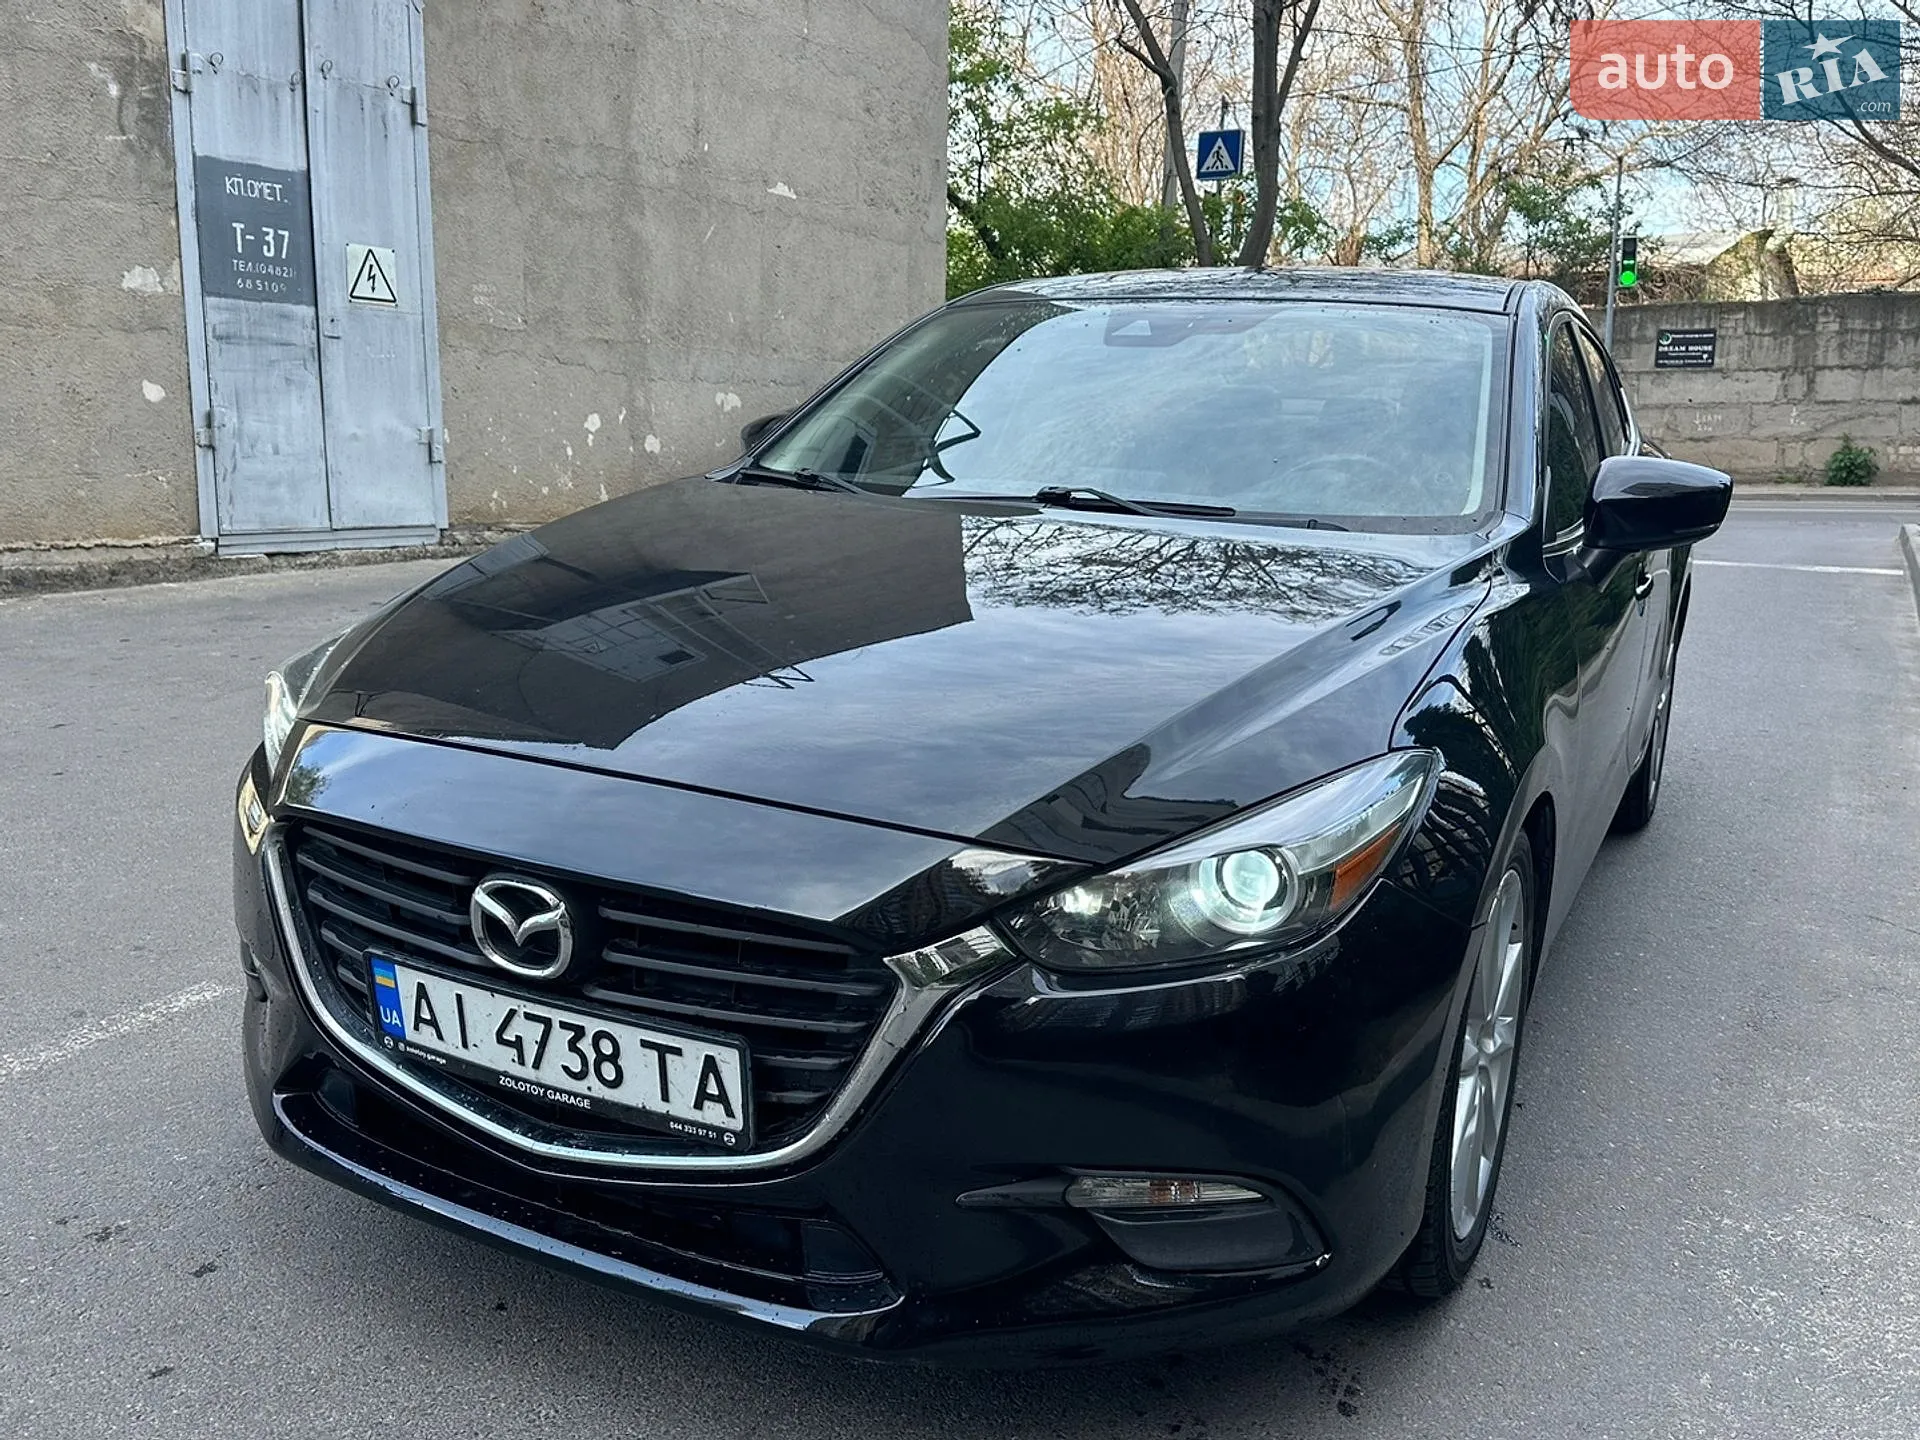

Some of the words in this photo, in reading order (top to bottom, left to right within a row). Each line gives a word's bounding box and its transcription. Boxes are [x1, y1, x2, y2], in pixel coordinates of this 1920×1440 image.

[380, 1005, 402, 1028] UA
[413, 981, 469, 1050] AI
[495, 1008, 624, 1090] 4738
[641, 1038, 736, 1120] TA
[499, 1075, 545, 1097] ZOLOTOY
[547, 1089, 591, 1109] GARAGE
